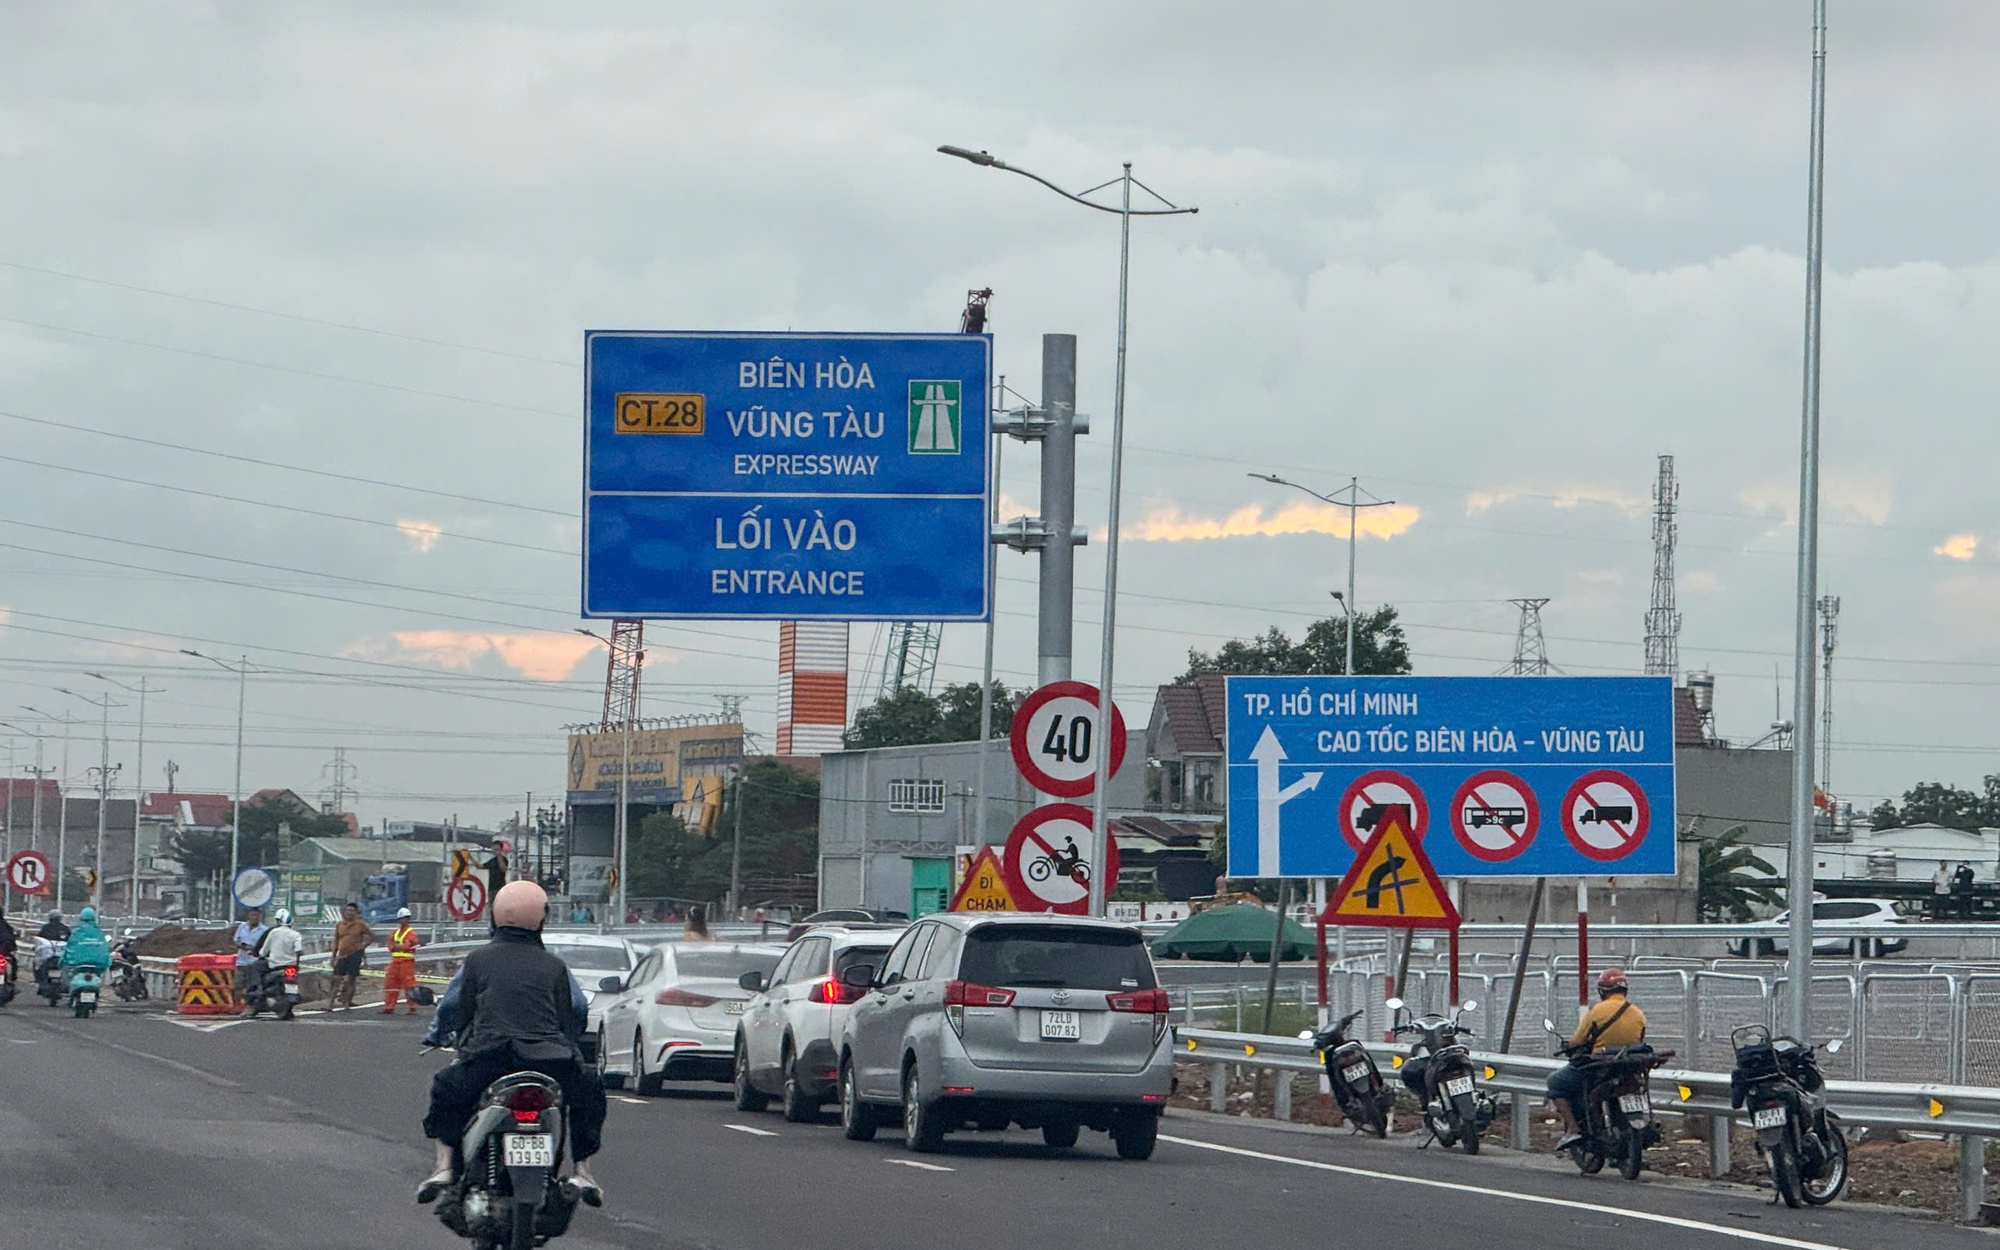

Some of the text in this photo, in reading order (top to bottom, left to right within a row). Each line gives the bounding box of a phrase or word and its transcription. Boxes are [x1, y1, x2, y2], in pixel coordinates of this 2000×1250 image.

[739, 356, 875, 389] BIÊN HÒA
[621, 400, 698, 427] CT.28
[727, 405, 884, 438] VŨNG TÀU
[734, 455, 879, 476] EXPRESSWAY
[715, 505, 856, 550] LỐI VÀO
[712, 570, 864, 595] ENTRANCE
[1244, 686, 1418, 716] TP. HỒ CHÍ MINH
[1042, 714, 1092, 763] 40
[1317, 730, 1361, 753] CAO
[1366, 724, 1408, 753] TỐC
[1415, 725, 1465, 753] BIÊN
[1473, 726, 1518, 753] HÒA
[1541, 726, 1601, 753] VŨNG
[1606, 726, 1644, 753] TÀU
[980, 876, 993, 889] ĐI
[1045, 1024, 1077, 1037] 007.82
[1049, 1012, 1072, 1024] 72LD
